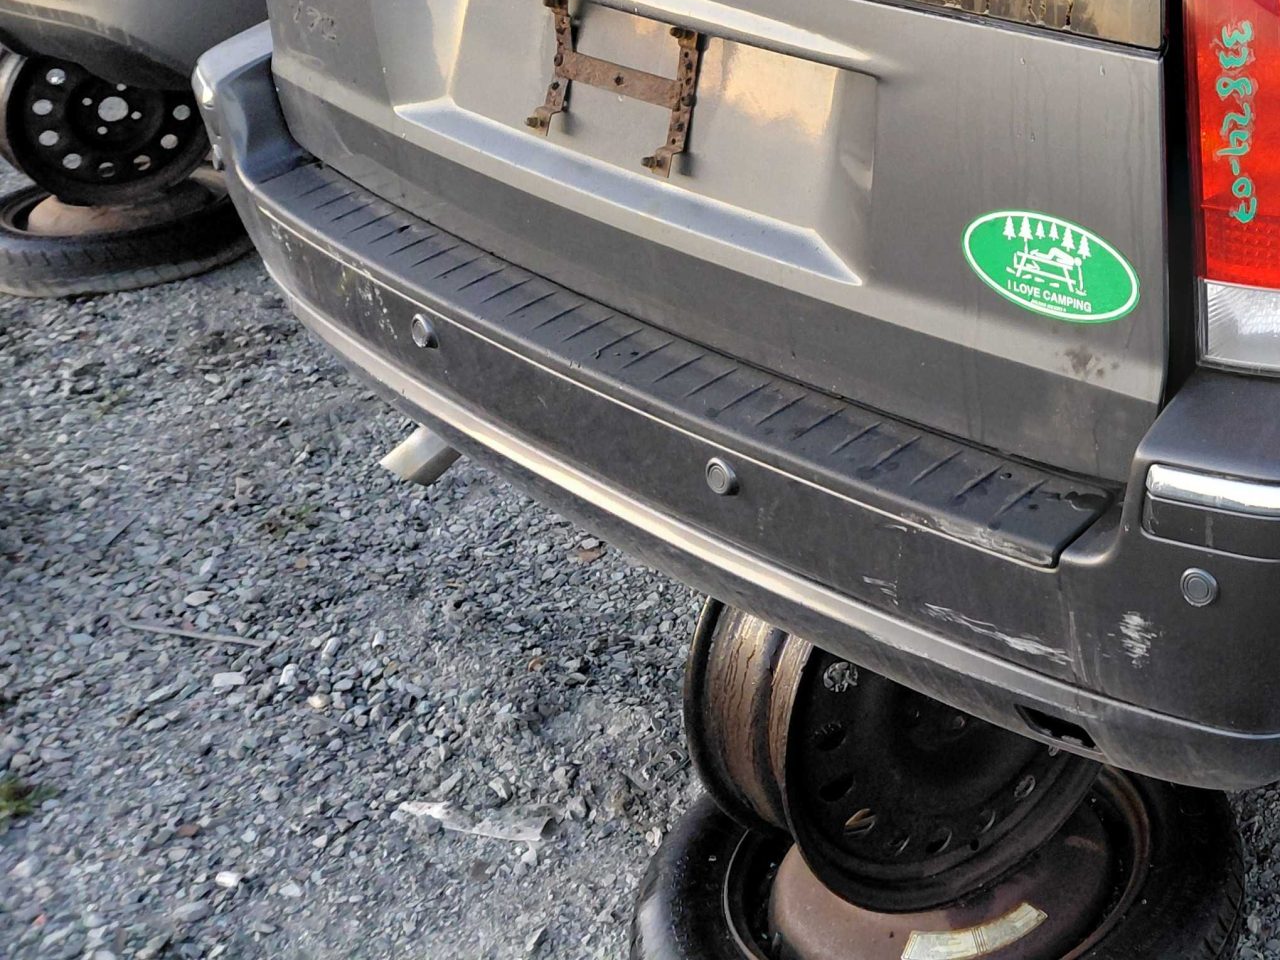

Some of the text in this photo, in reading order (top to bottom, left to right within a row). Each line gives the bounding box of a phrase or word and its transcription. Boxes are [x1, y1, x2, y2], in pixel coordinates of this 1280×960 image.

[1216, 20, 1257, 224] 33824-07
[1007, 280, 1011, 290] I
[1013, 281, 1041, 299] LOVE
[1043, 290, 1092, 313] CAMPING
